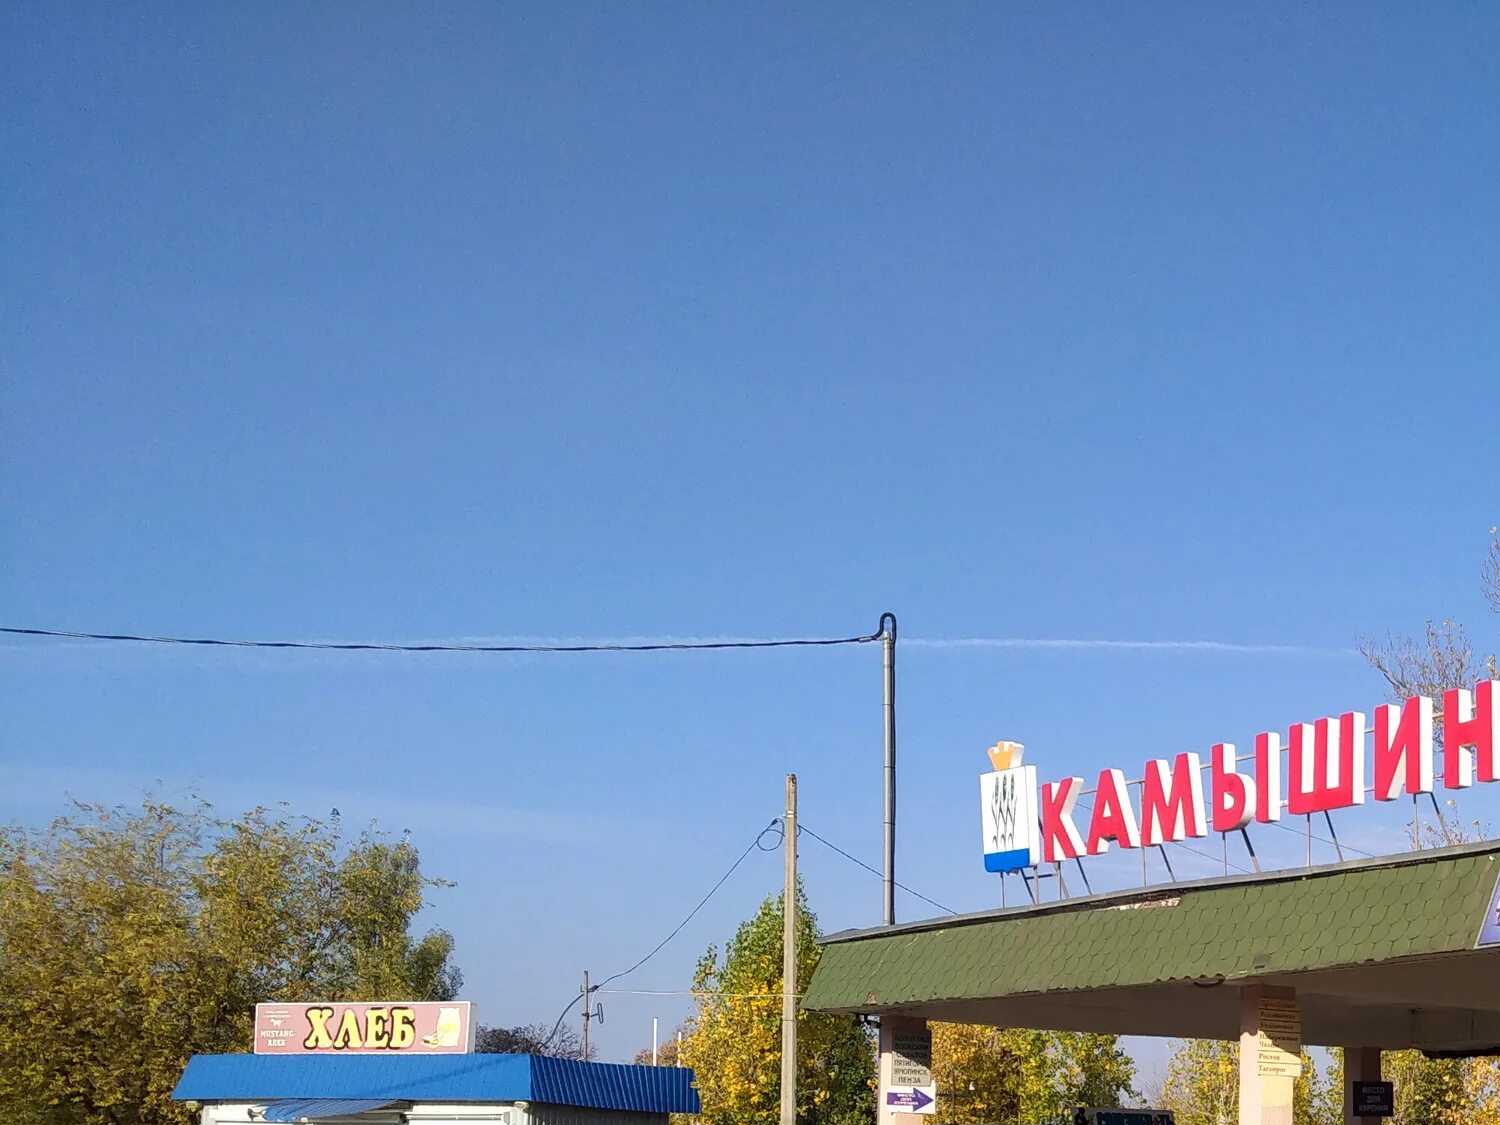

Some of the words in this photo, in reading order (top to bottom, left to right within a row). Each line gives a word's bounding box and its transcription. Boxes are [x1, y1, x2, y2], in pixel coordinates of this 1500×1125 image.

[303, 1006, 416, 1050] ХЛЕБ
[1259, 1053, 1280, 1061] Ростов
[893, 1067, 928, 1076] УРЮПИНСК
[898, 1076, 921, 1084] ПЕНЗА
[1362, 1086, 1385, 1094] МЕСТО
